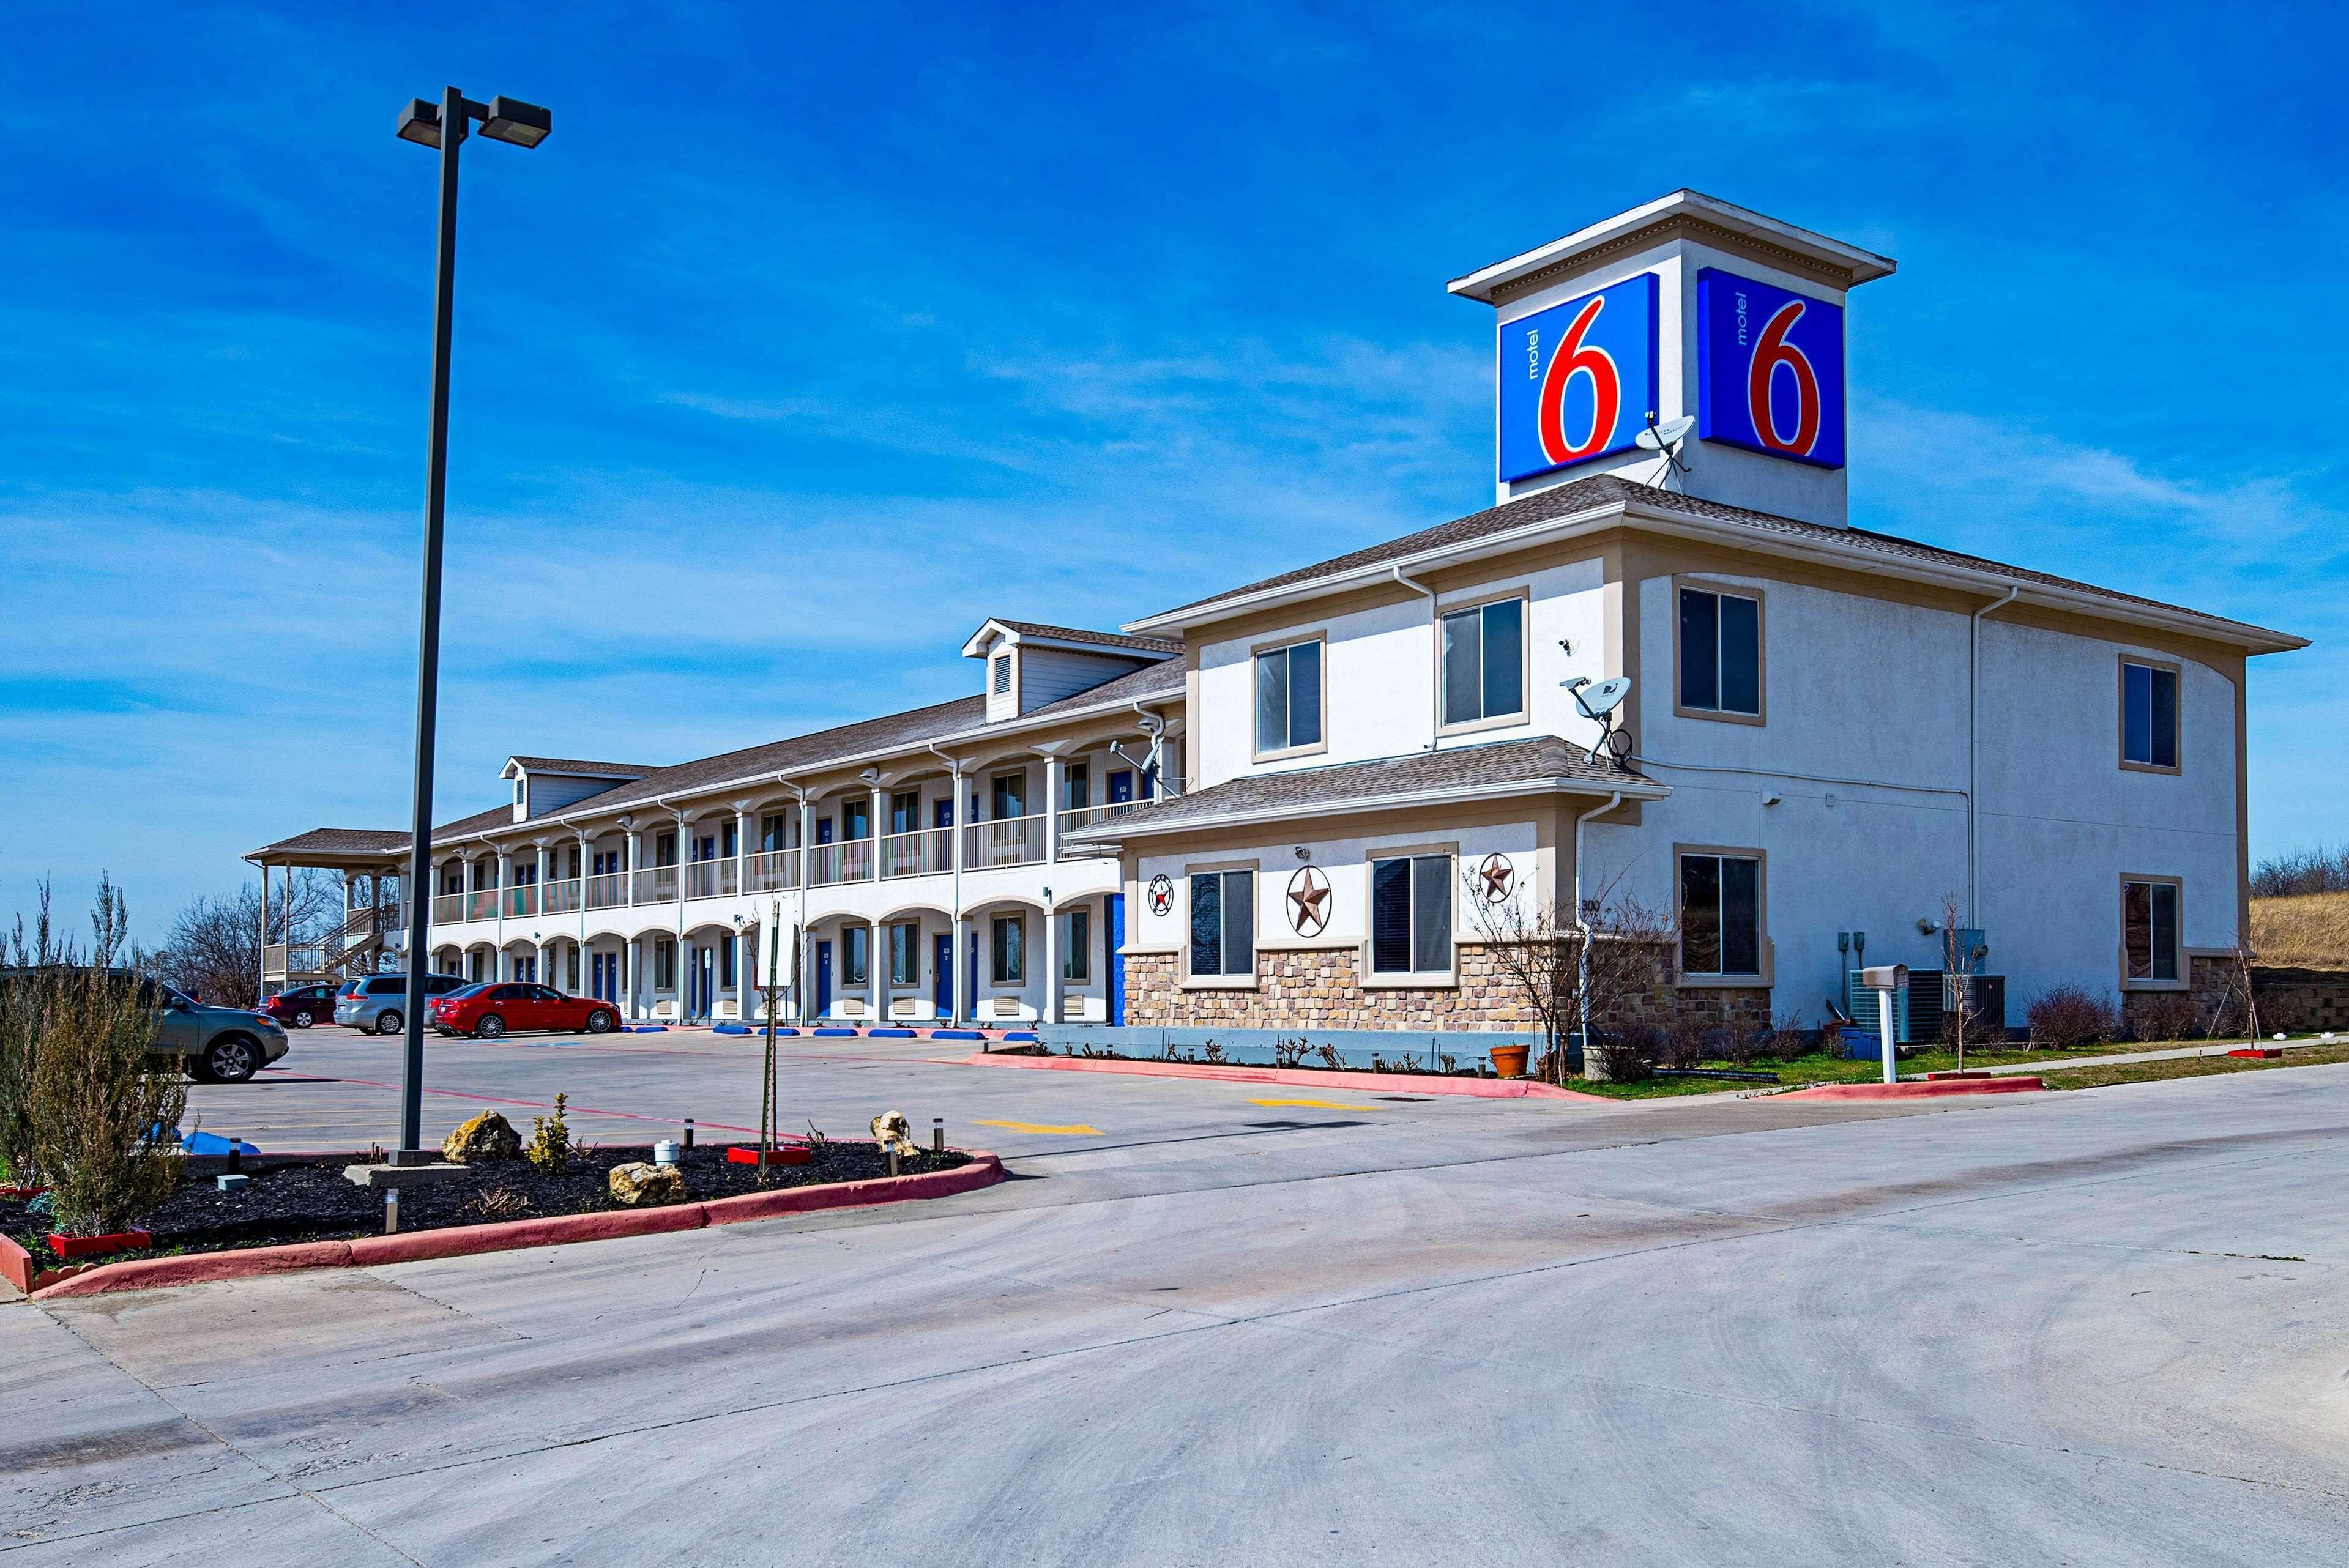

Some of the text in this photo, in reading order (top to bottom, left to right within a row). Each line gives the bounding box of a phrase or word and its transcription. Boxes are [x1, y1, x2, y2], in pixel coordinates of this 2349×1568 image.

[1527, 295, 1621, 464] motel 6
[1735, 292, 1821, 456] motel 6
